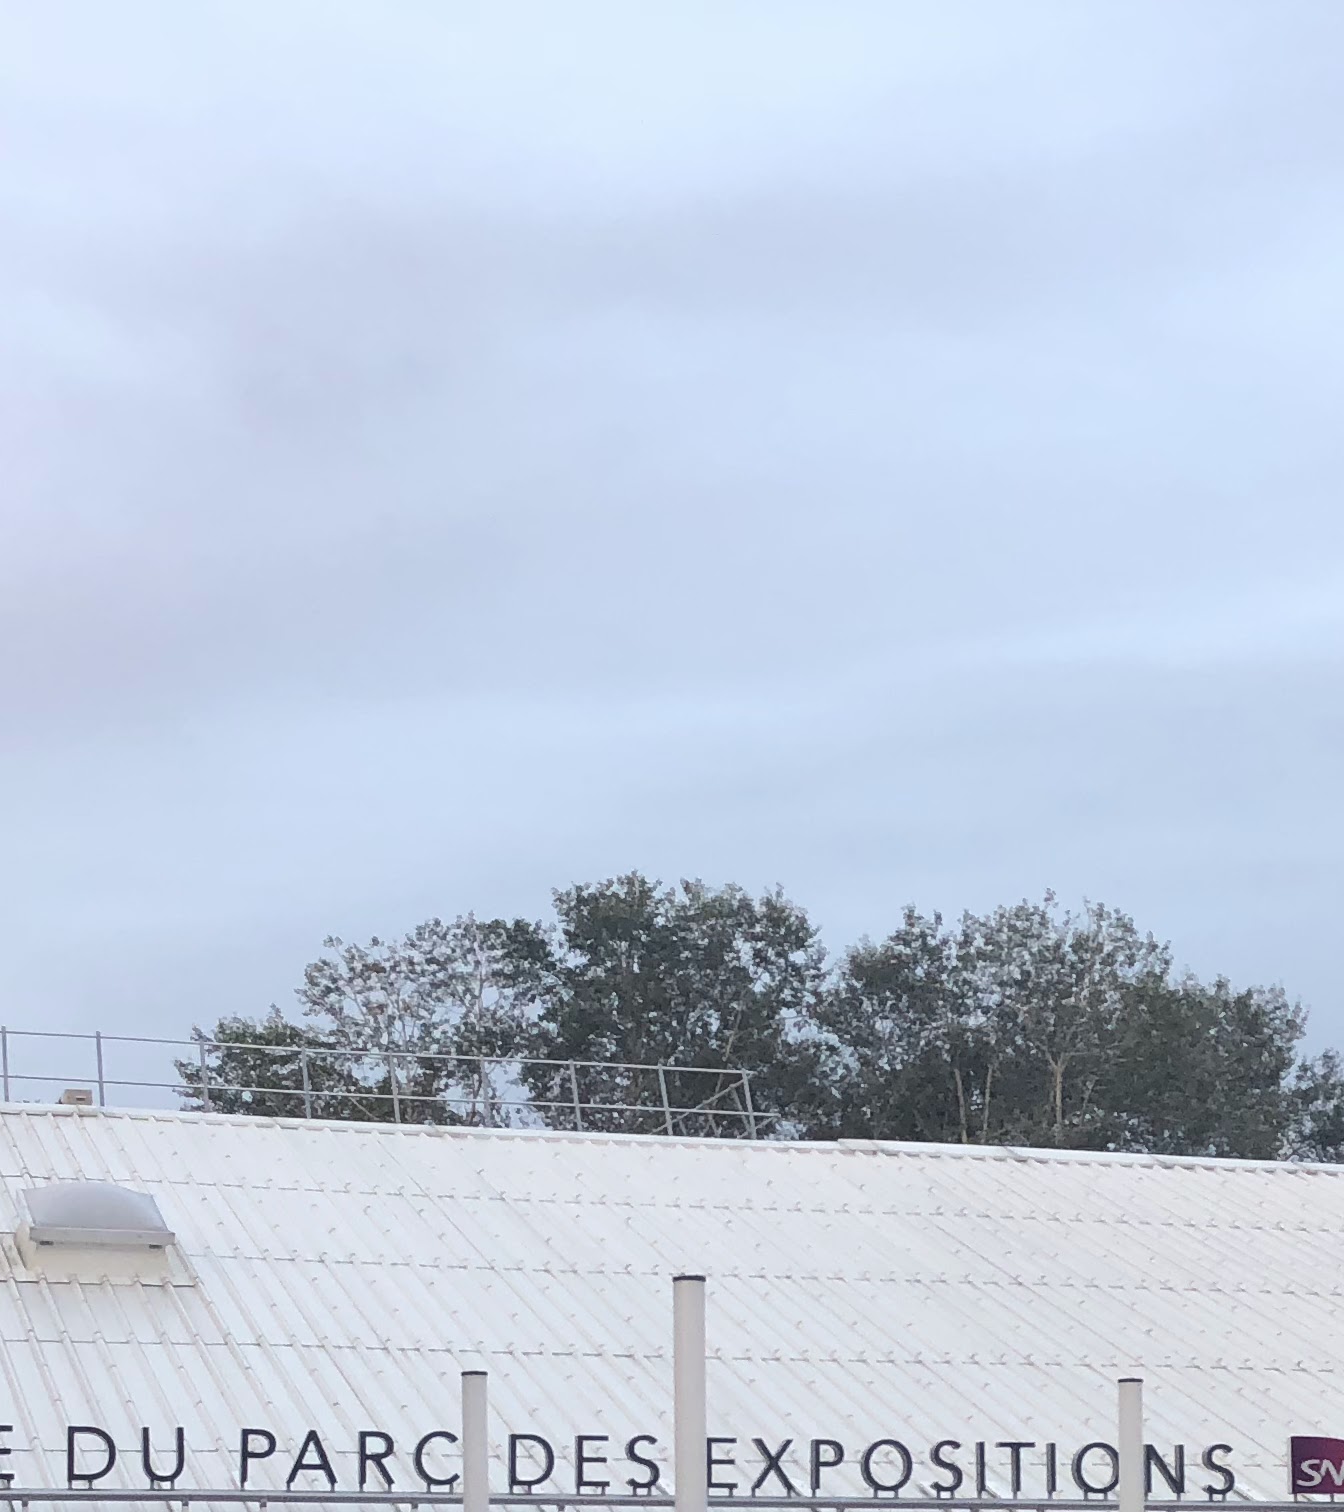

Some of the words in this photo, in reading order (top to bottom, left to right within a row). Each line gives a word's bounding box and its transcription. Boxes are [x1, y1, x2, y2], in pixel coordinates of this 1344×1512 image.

[67, 1426, 184, 1482] DU
[240, 1428, 460, 1486] PARC
[508, 1433, 661, 1488] DES
[706, 1437, 1235, 1496] EXPOSITIONS
